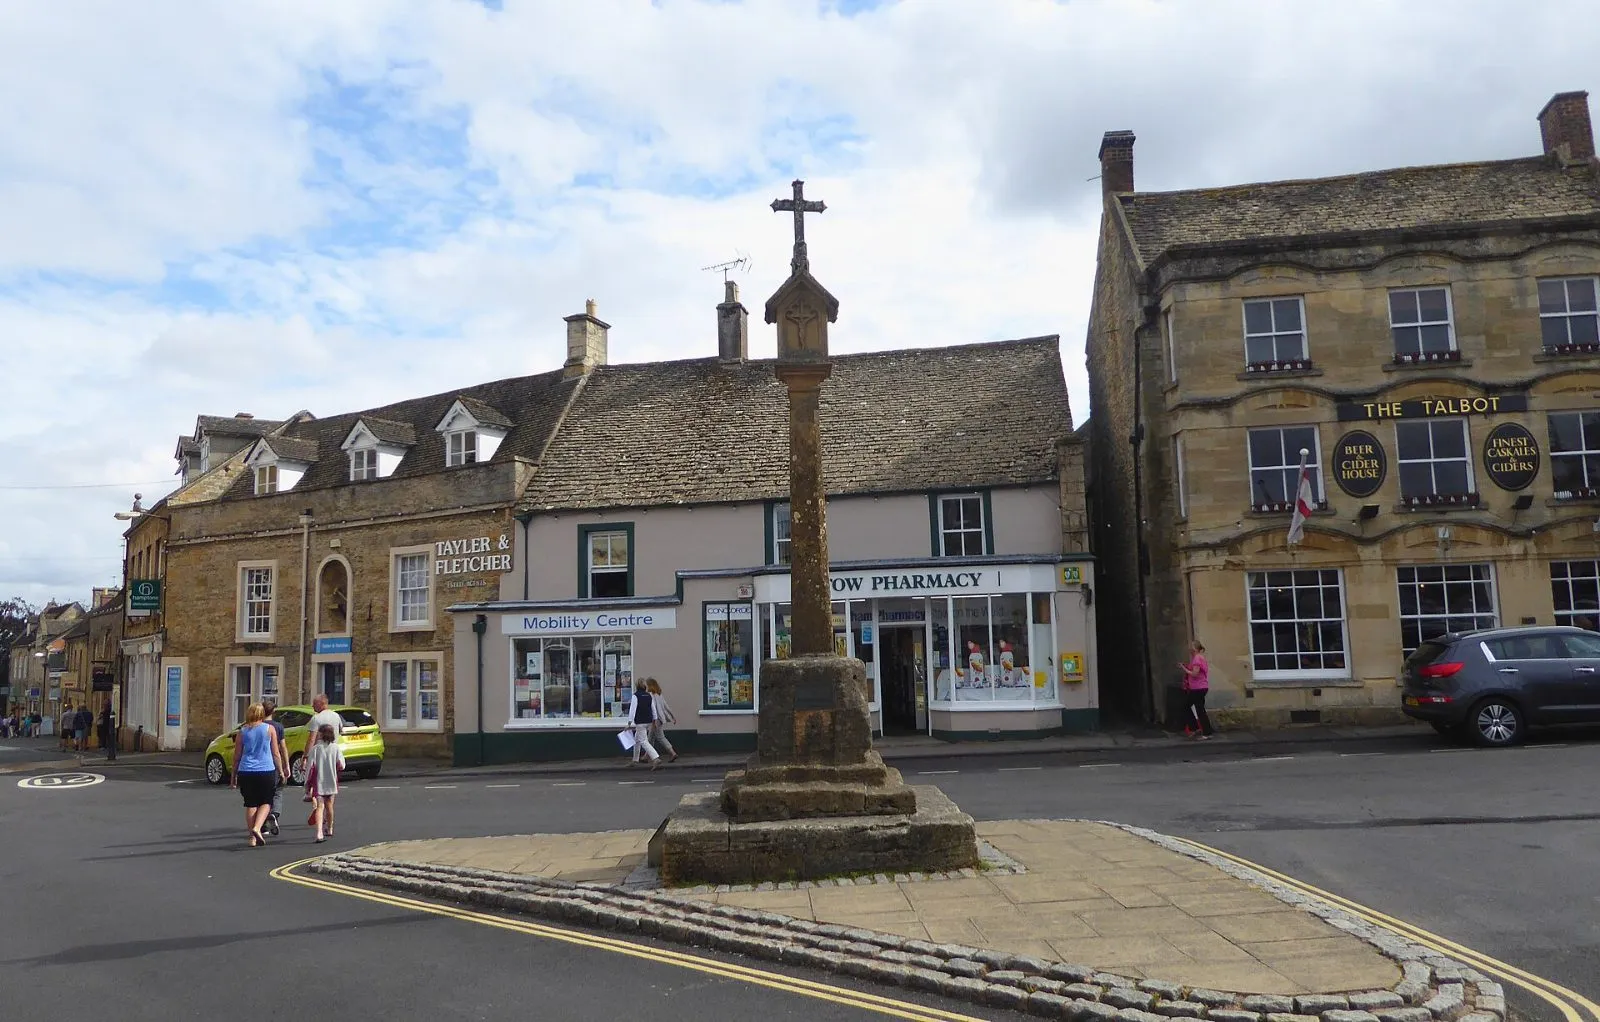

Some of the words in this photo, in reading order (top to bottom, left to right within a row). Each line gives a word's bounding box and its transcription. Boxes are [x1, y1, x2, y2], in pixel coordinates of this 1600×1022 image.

[1363, 402, 1402, 417] THE
[1421, 396, 1500, 415] TALBOT
[1493, 436, 1528, 447] FINEST
[1344, 444, 1373, 454] BEER
[1341, 459, 1379, 470] CIDER
[1492, 461, 1534, 472] CIDERS
[1342, 469, 1379, 479] HOUSE
[435, 536, 491, 556] TAYLER
[498, 534, 510, 550] &
[435, 554, 512, 575] FLETCHER
[871, 572, 982, 591] PHARMACY
[523, 616, 590, 630] Mobility
[596, 614, 653, 627] Centre
